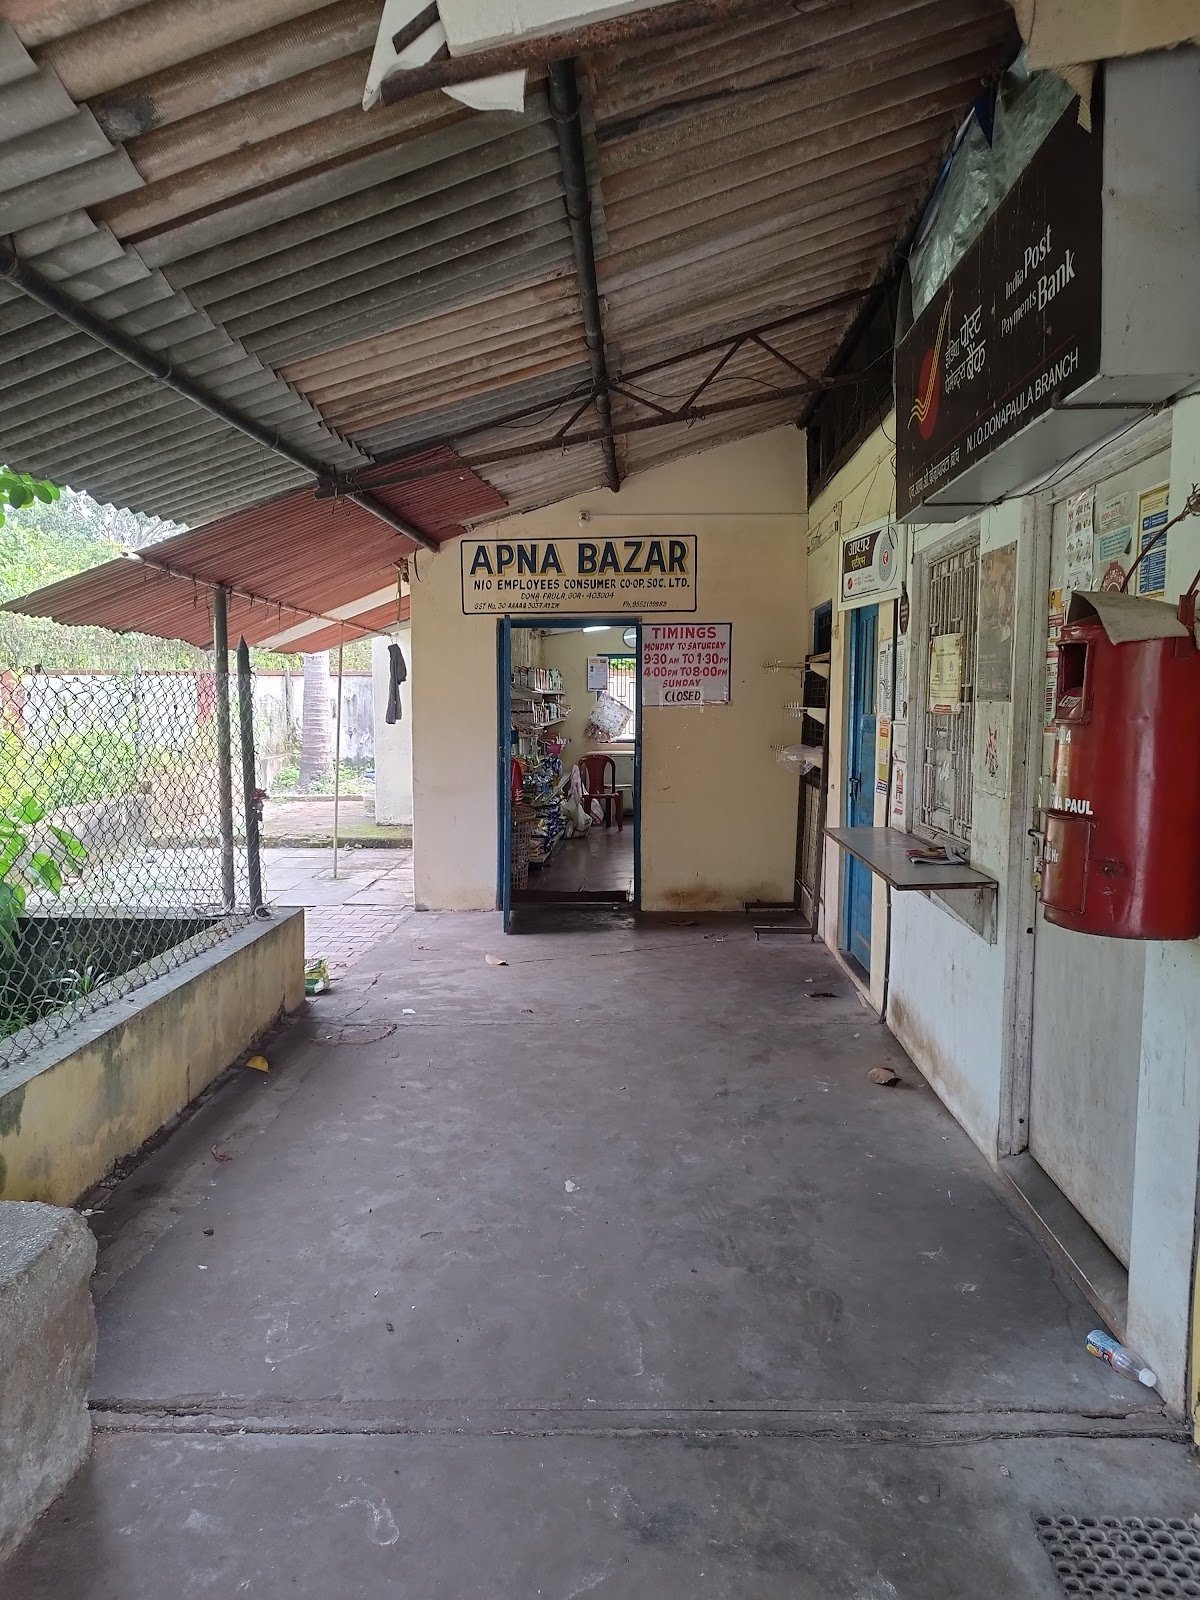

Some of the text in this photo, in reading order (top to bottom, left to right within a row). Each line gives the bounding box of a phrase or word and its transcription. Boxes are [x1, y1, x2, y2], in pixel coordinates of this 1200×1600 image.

[1005, 224, 1053, 300] India Post
[1001, 248, 1076, 338] Payments Bank
[960, 304, 983, 348] पोस्ट
[966, 338, 987, 380] बैंक
[1034, 346, 1079, 401] BRANCH
[469, 540, 690, 577] APNA BAZAR
[474, 579, 493, 591] NIO
[497, 579, 560, 590] EMPLOYEES
[563, 578, 617, 590] CONSUMER
[474, 602, 486, 610] GST
[652, 627, 717, 639] TIMINGS
[643, 642, 727, 651] MONDAY TO SATURDAY
[682, 653, 695, 664] TO
[680, 667, 692, 676] TO
[662, 678, 702, 688] SUNDAY
[664, 690, 702, 702] CLOSED
[1065, 797, 1094, 816] PAUL
